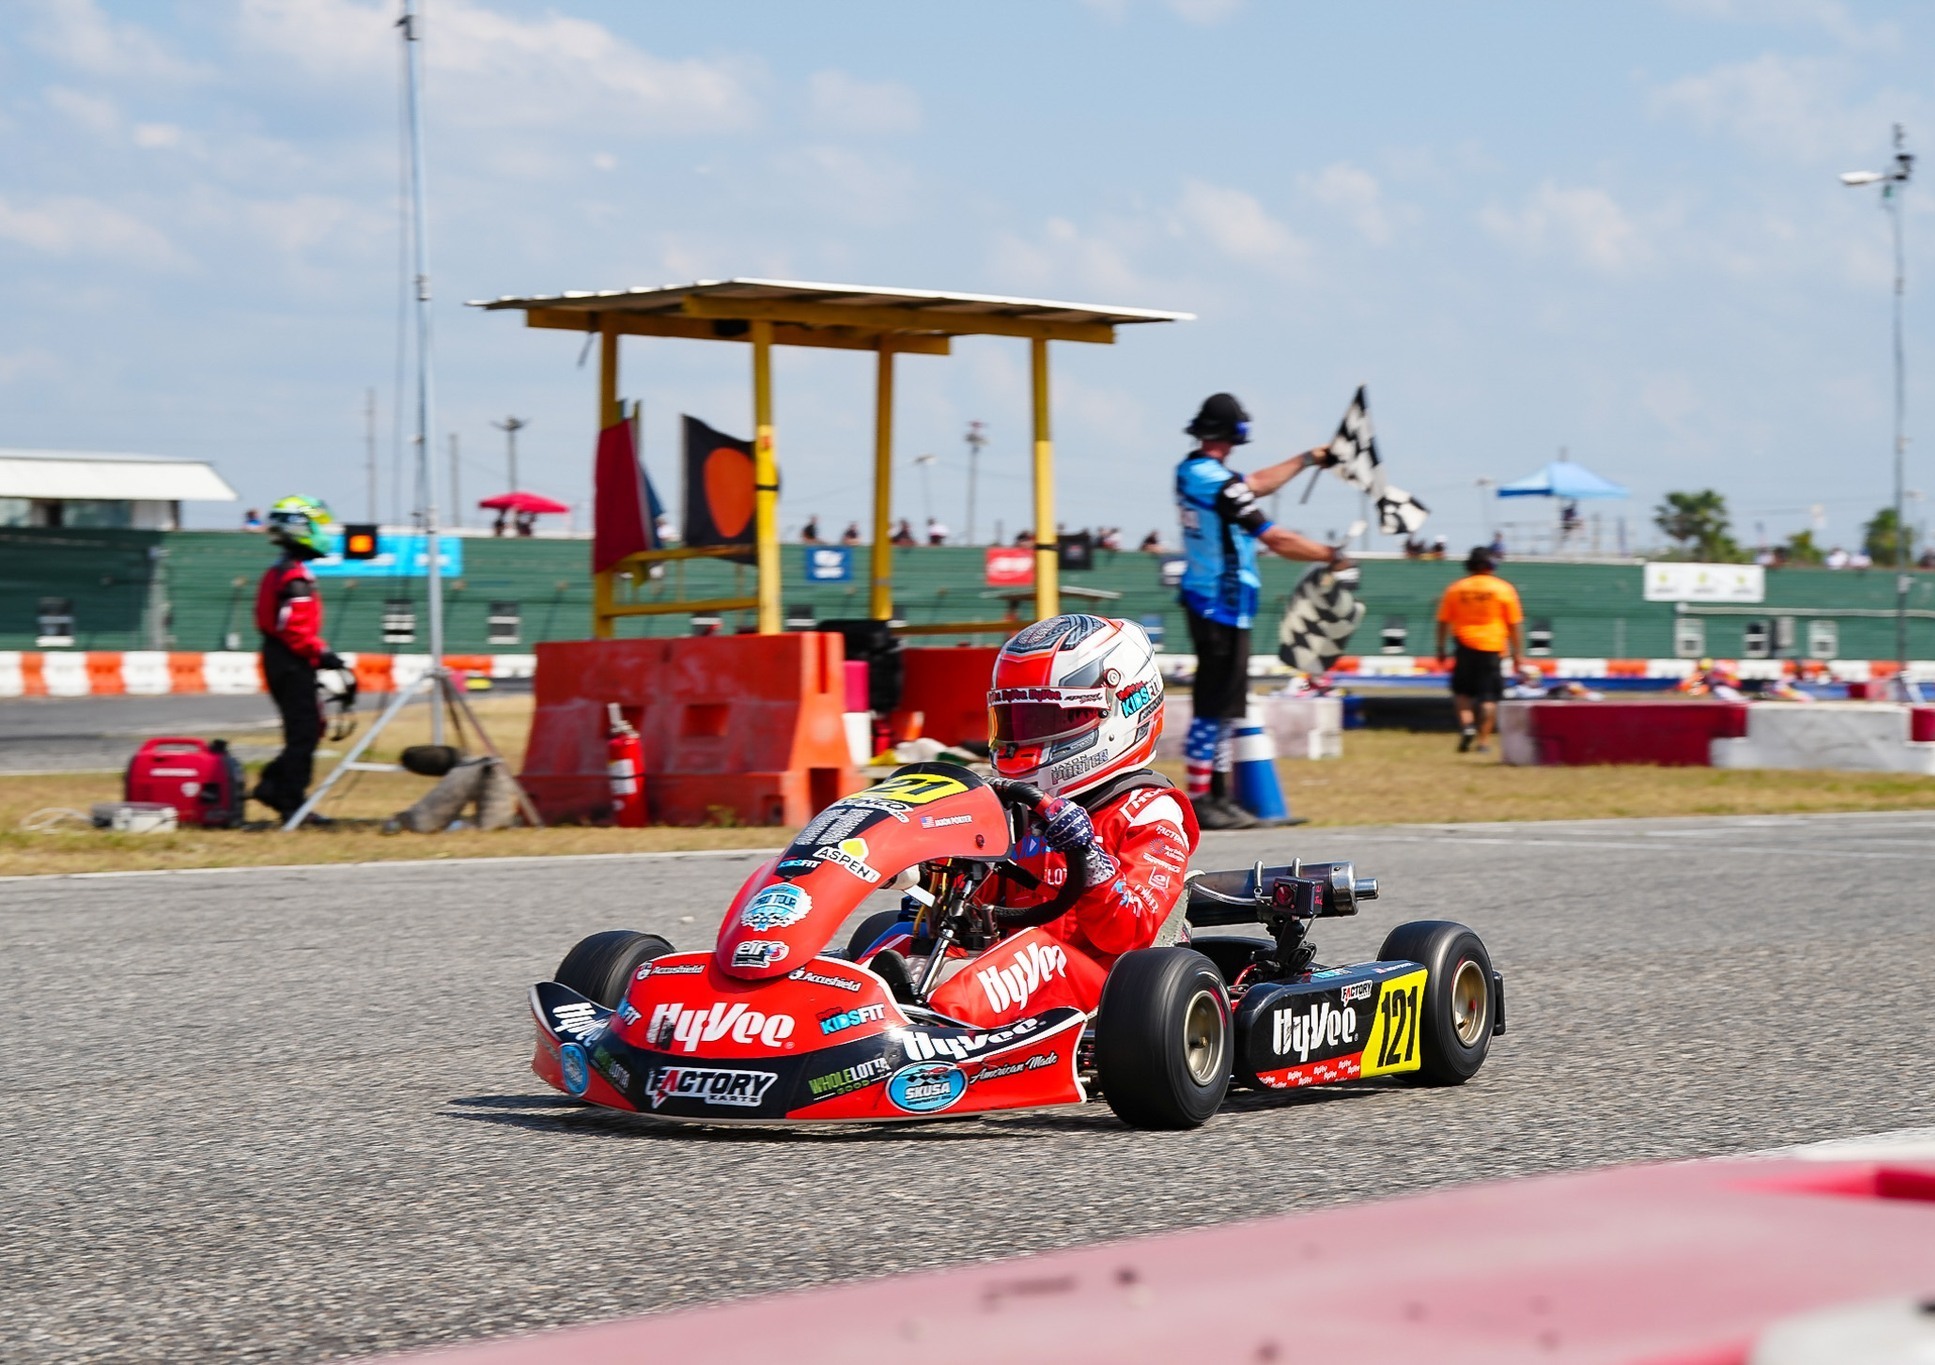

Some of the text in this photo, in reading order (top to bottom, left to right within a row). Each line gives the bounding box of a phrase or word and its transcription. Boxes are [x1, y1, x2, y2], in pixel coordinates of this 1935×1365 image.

[1051, 754, 1087, 772] JAXON
[1051, 748, 1109, 786] PORTER
[818, 848, 871, 878] ASPEN
[802, 971, 862, 993] Accushield
[1342, 982, 1372, 1000] FACTORY
[819, 1003, 885, 1035] KIDSFIT
[1377, 985, 1418, 1068] 121
[649, 1068, 773, 1096] FACTORY
[969, 1052, 1059, 1084] American Made
[904, 1081, 951, 1100] SKUSA
